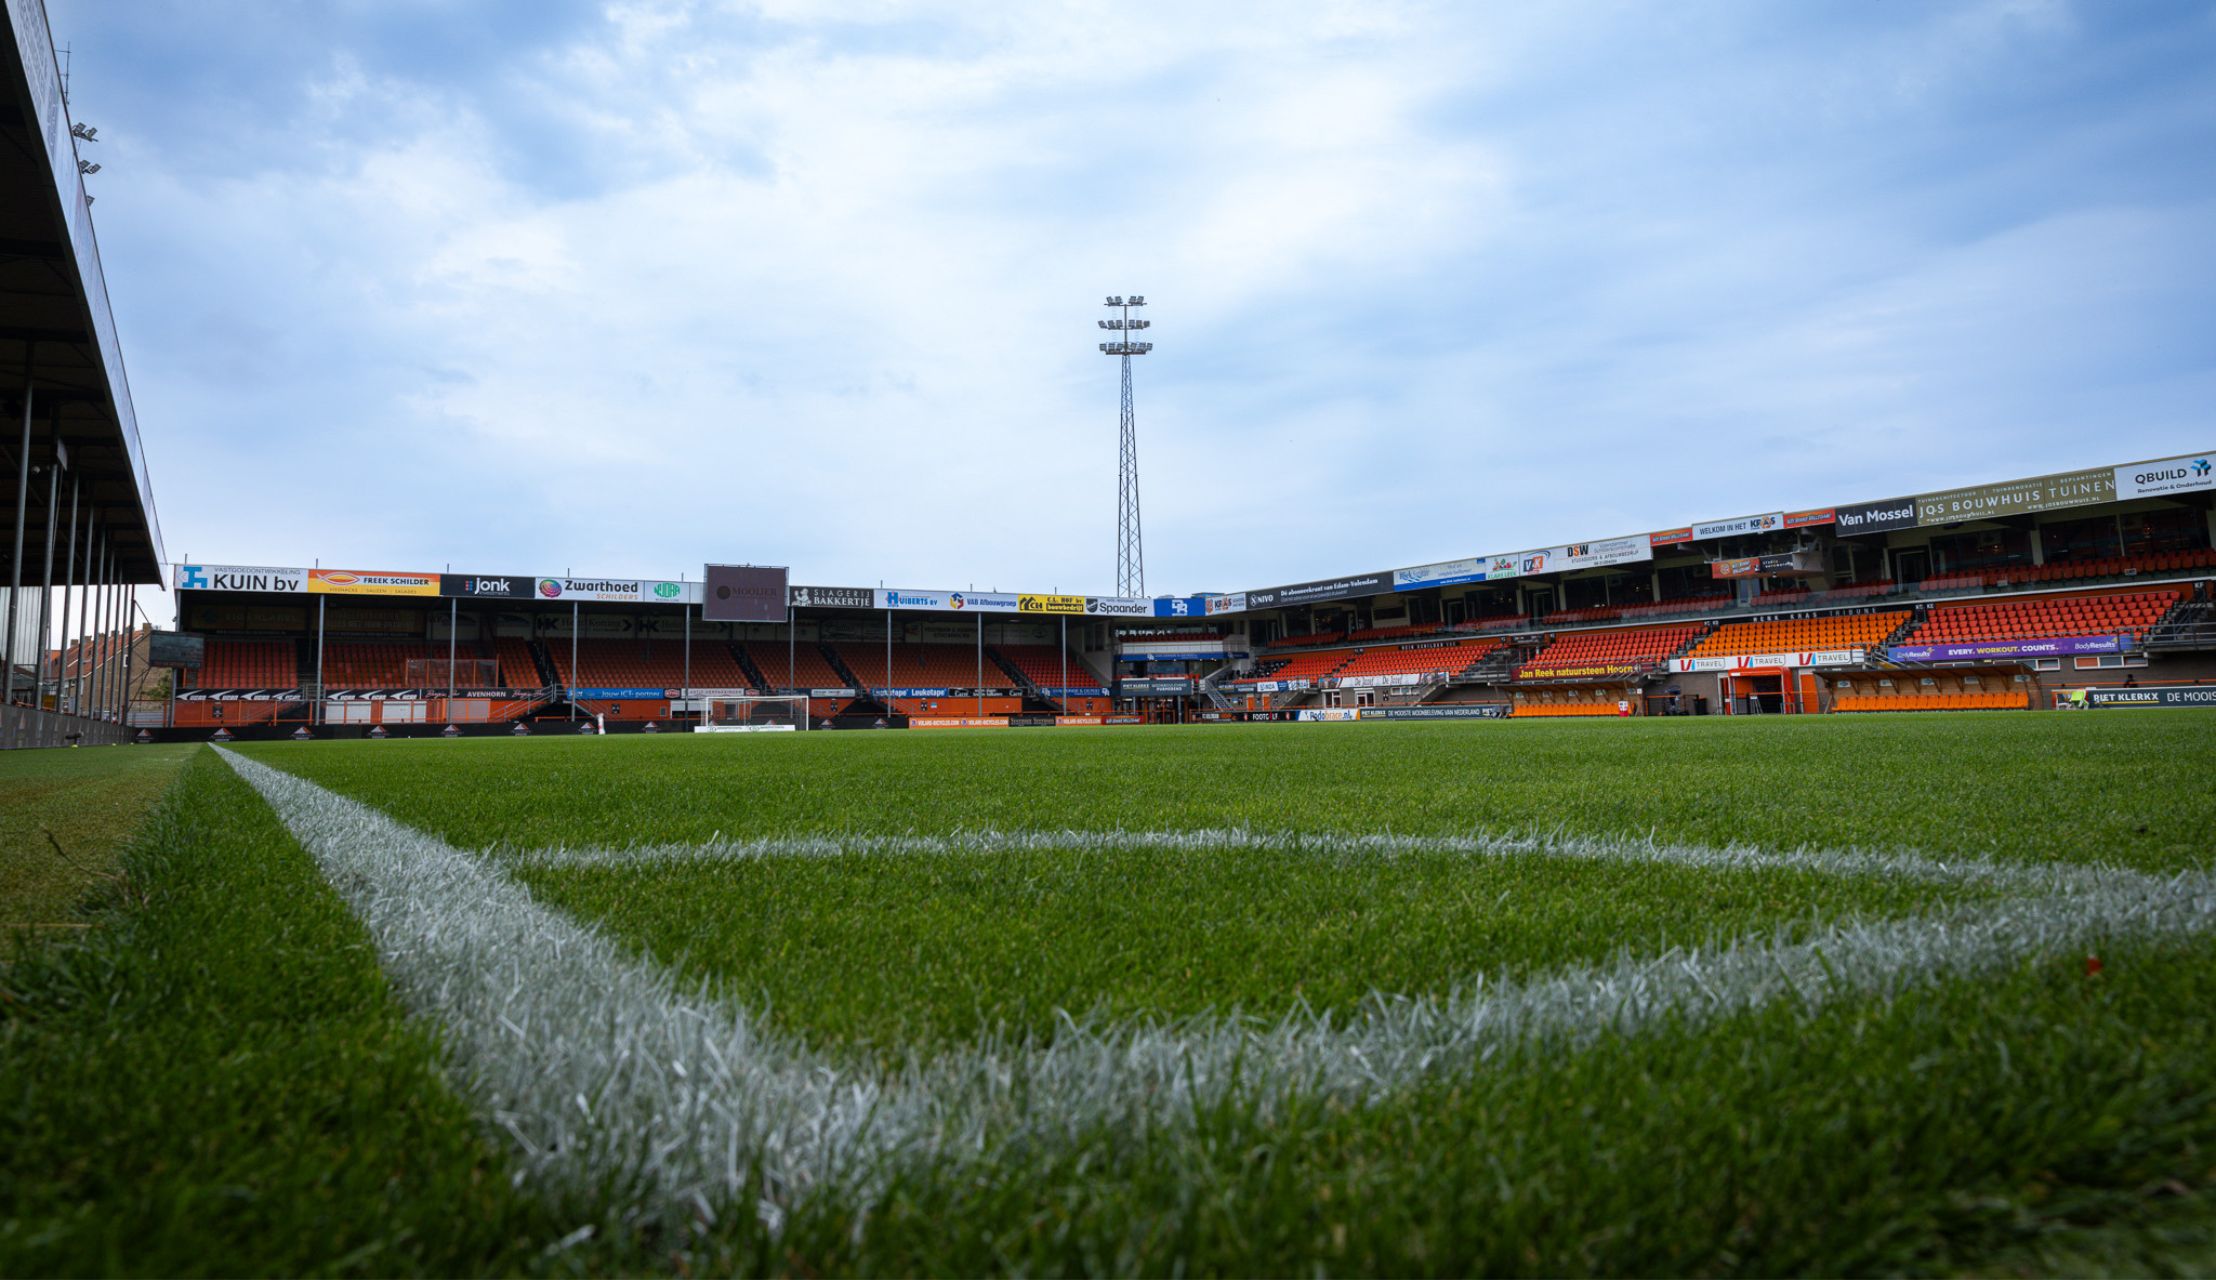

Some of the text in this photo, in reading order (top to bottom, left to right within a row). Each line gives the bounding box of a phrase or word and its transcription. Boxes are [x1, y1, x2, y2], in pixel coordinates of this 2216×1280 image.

[2135, 468, 2187, 485] QBUILD
[2137, 485, 2168, 494] Renovatie
[2176, 480, 2212, 488] Onderhoud
[1952, 490, 2041, 512] BOUWHUIS
[2048, 479, 2116, 498] TUINEN
[1838, 514, 1863, 527] Van
[1866, 505, 1914, 523] Mossel
[1700, 523, 1747, 536] WELKOM IN HET
[1567, 544, 1589, 558] DSW
[214, 567, 301, 575] VASTGOEDONTWIKKELING
[213, 574, 299, 591] KUIN bv
[363, 577, 430, 586] FREEK SCHILDER
[565, 580, 638, 593] Zwarthoed
[814, 589, 870, 598] SLAGERIJ
[814, 597, 871, 607] BAKKERTJE
[1100, 603, 1148, 614] Spaander
[1753, 607, 1876, 622] HENK KRAS TRIBUNE
[1976, 646, 2020, 654] WORKOUT.
[2022, 644, 2059, 652] COUNTS.
[2075, 642, 2116, 650] BodyResults
[1696, 660, 1723, 668] TRAVEL
[1755, 657, 1783, 665] TRAVEL
[1817, 654, 1848, 663] TRAVEL
[1519, 665, 1633, 679] Jan Reek natuursteen Hoorn
[2093, 694, 2116, 702] PIET
[2118, 693, 2159, 701] KLERKX
[2167, 692, 2181, 702] DE
